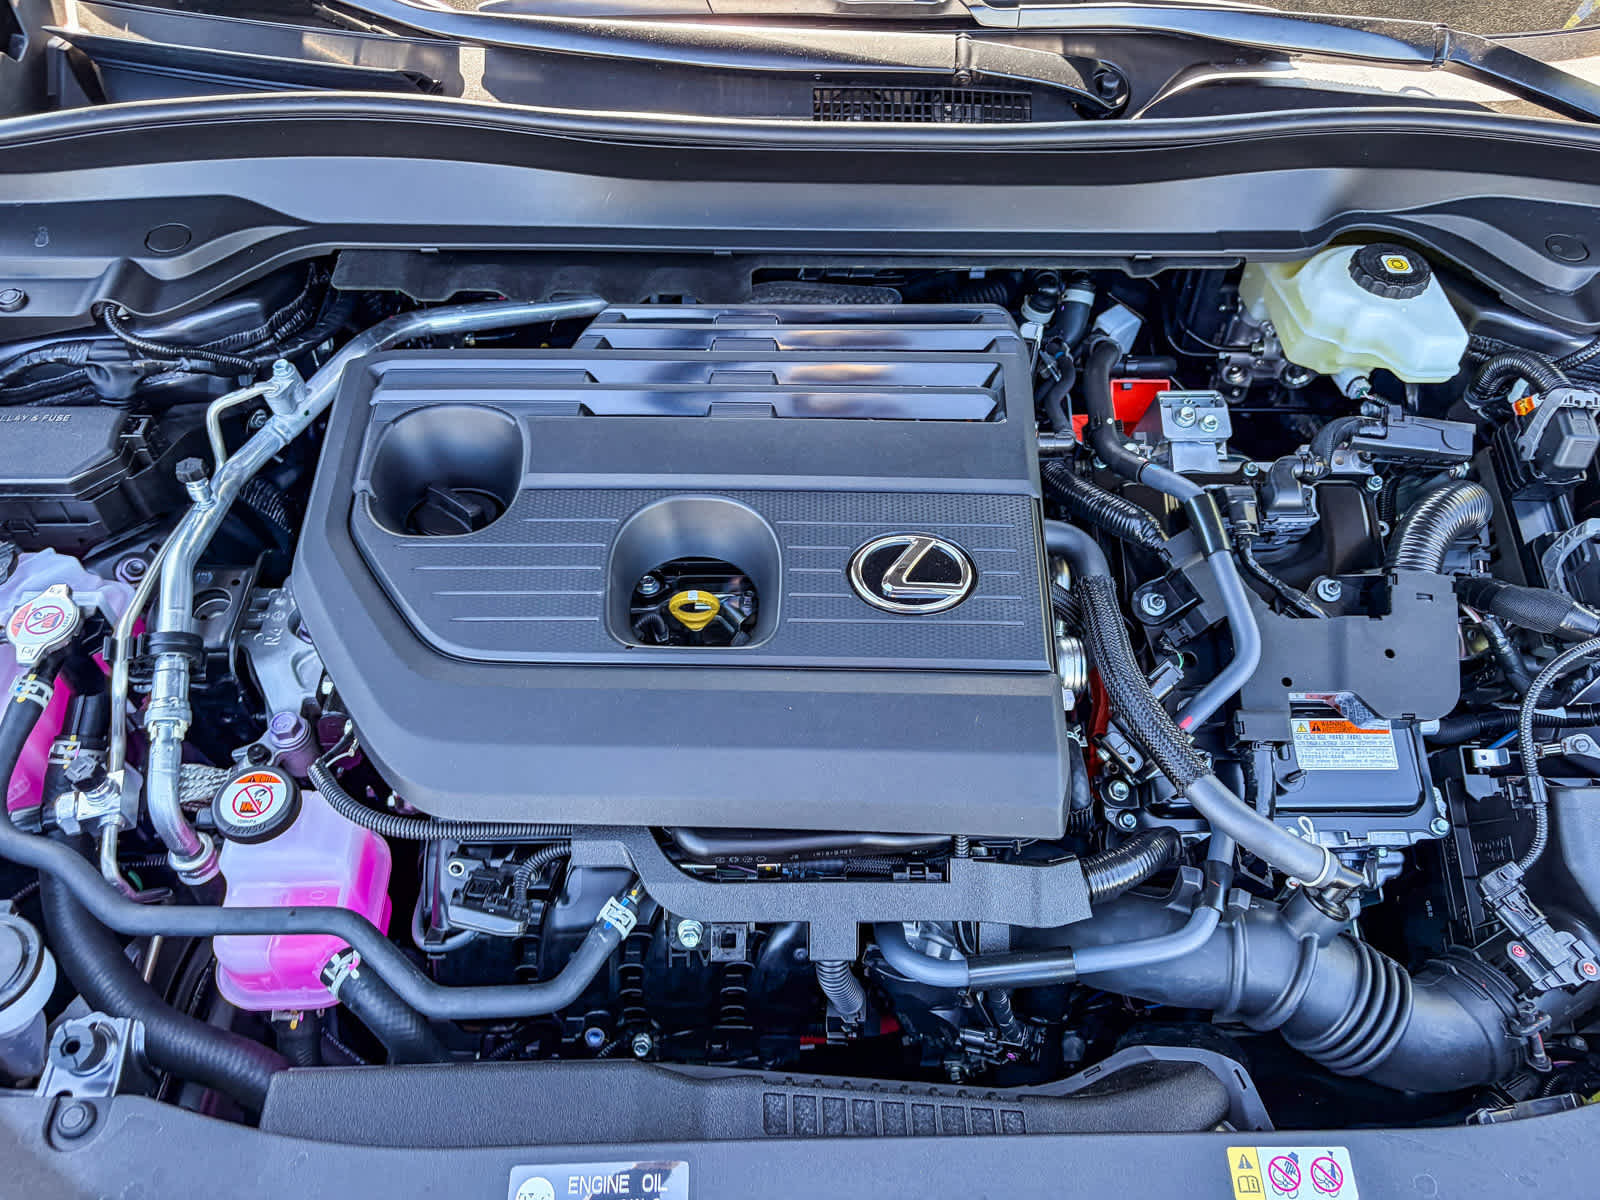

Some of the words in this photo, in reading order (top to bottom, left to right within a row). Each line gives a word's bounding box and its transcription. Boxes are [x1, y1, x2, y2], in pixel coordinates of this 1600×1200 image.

[41, 414, 71, 422] FUSE
[225, 823, 266, 835] DENSO
[568, 1174, 630, 1194] ENGINE
[642, 1174, 668, 1193] OIL
